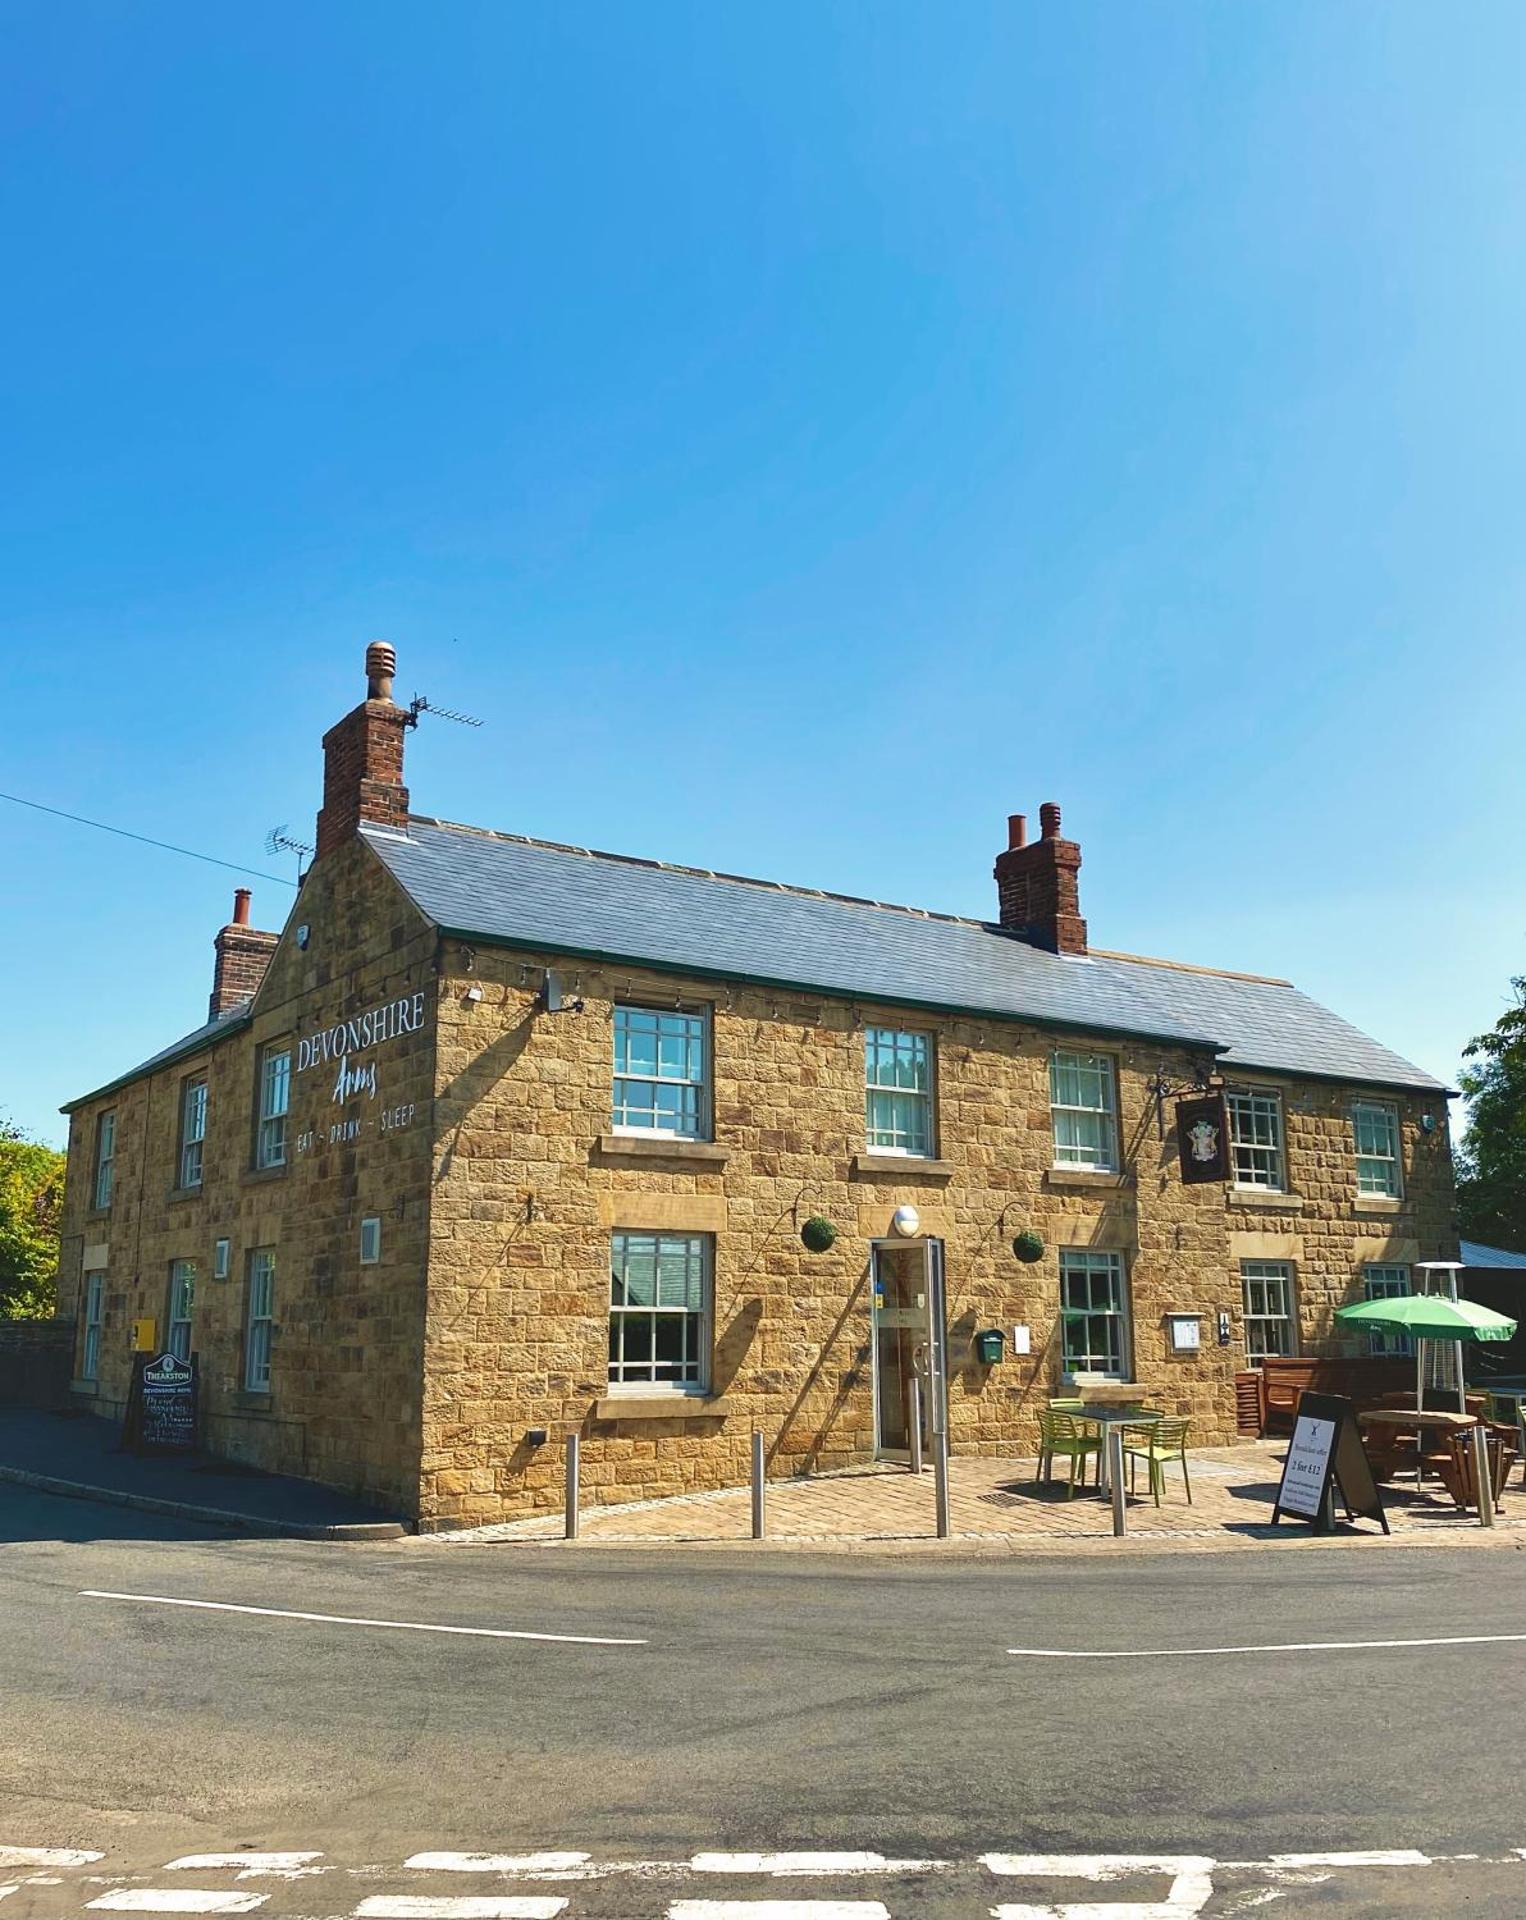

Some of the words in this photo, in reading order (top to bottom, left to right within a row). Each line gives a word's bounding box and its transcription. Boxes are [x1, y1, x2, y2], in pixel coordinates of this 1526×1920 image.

[297, 993, 425, 1072] DEVONSHIRE
[332, 1055, 376, 1105] Arms
[297, 1131, 314, 1153] EAT
[330, 1118, 361, 1144] DRINK
[381, 1104, 415, 1131] SLEEP
[1292, 1460, 1297, 1471] 2
[1297, 1461, 1308, 1472] for
[1307, 1463, 1321, 1476] £12
